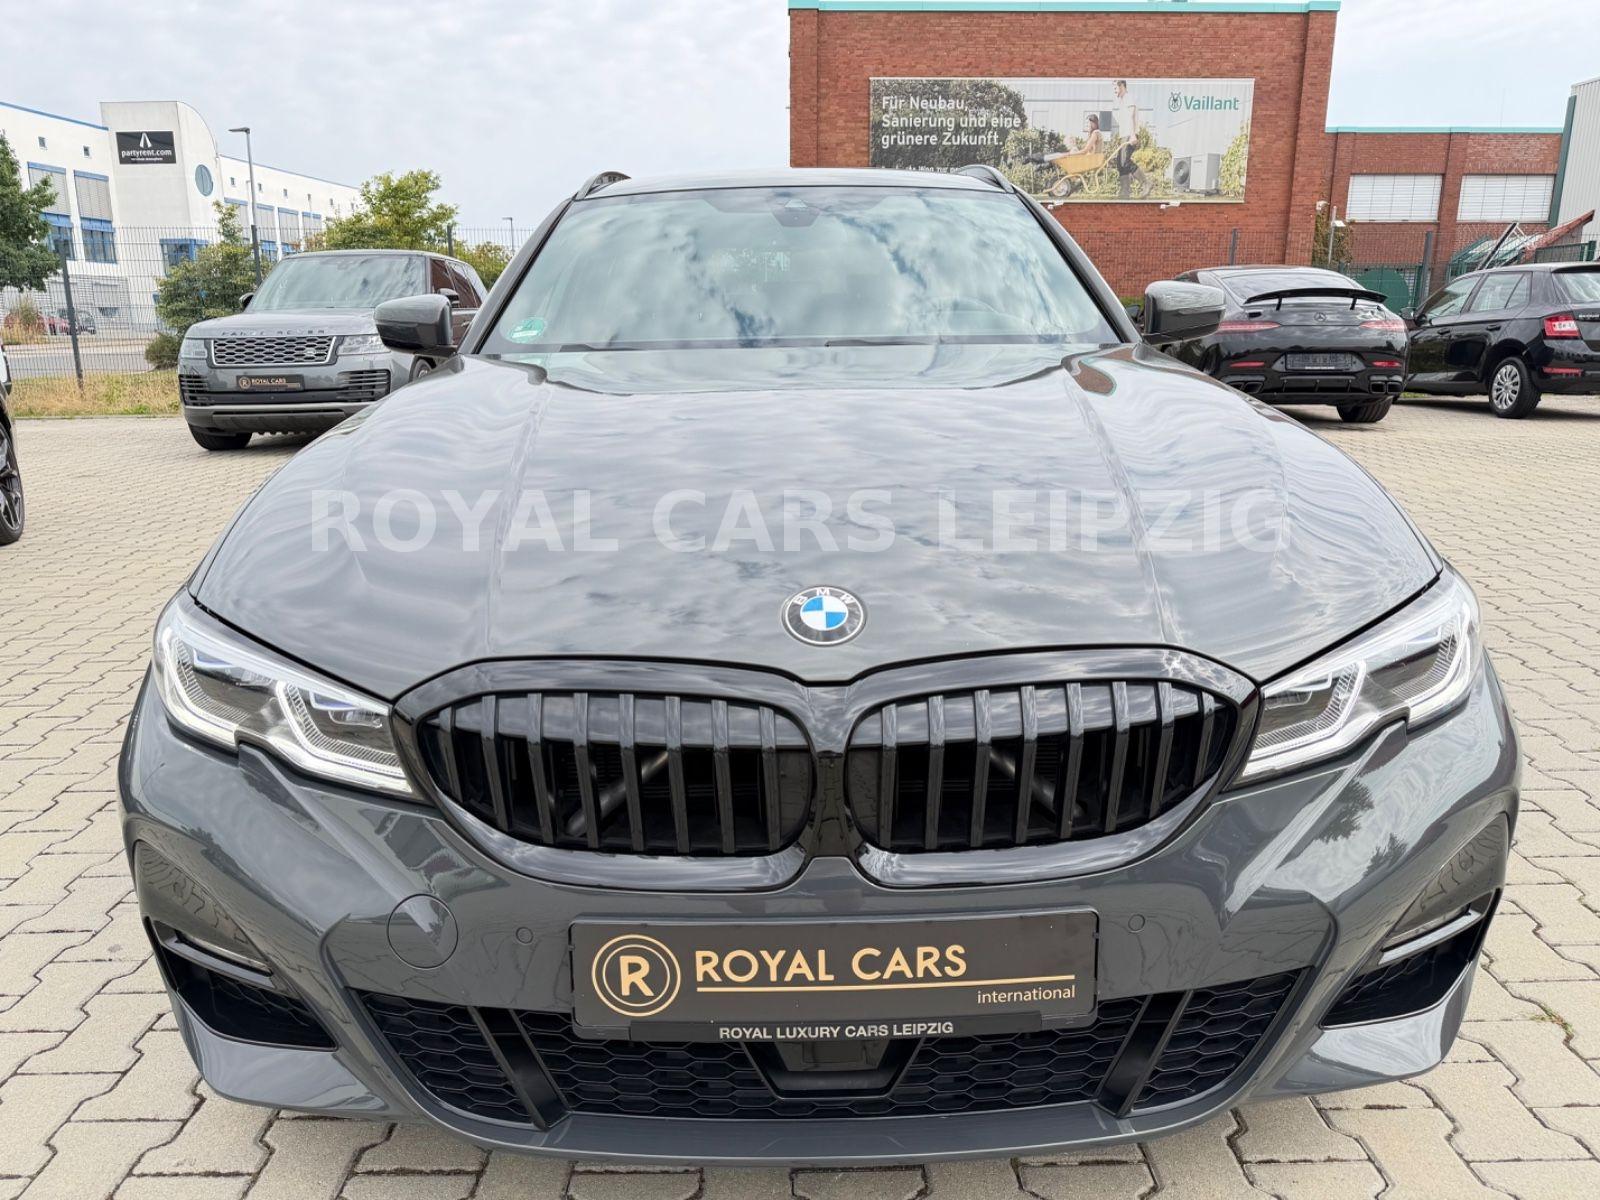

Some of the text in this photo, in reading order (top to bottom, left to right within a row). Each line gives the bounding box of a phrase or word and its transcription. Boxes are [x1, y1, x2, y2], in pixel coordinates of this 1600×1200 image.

[882, 95, 969, 112] Für Neubau,
[1183, 96, 1240, 111] Vaillant
[881, 114, 1022, 132] Sanierung und eine
[881, 130, 1004, 149] grünere Zukunft.
[121, 149, 172, 158] partyrent.com
[792, 586, 857, 606] BMW
[695, 944, 968, 983] ROYAL CARS
[619, 955, 655, 998] R
[977, 984, 1076, 1004] international
[718, 1021, 954, 1040] ROYAL LUXURY CARS LEIPZIG
